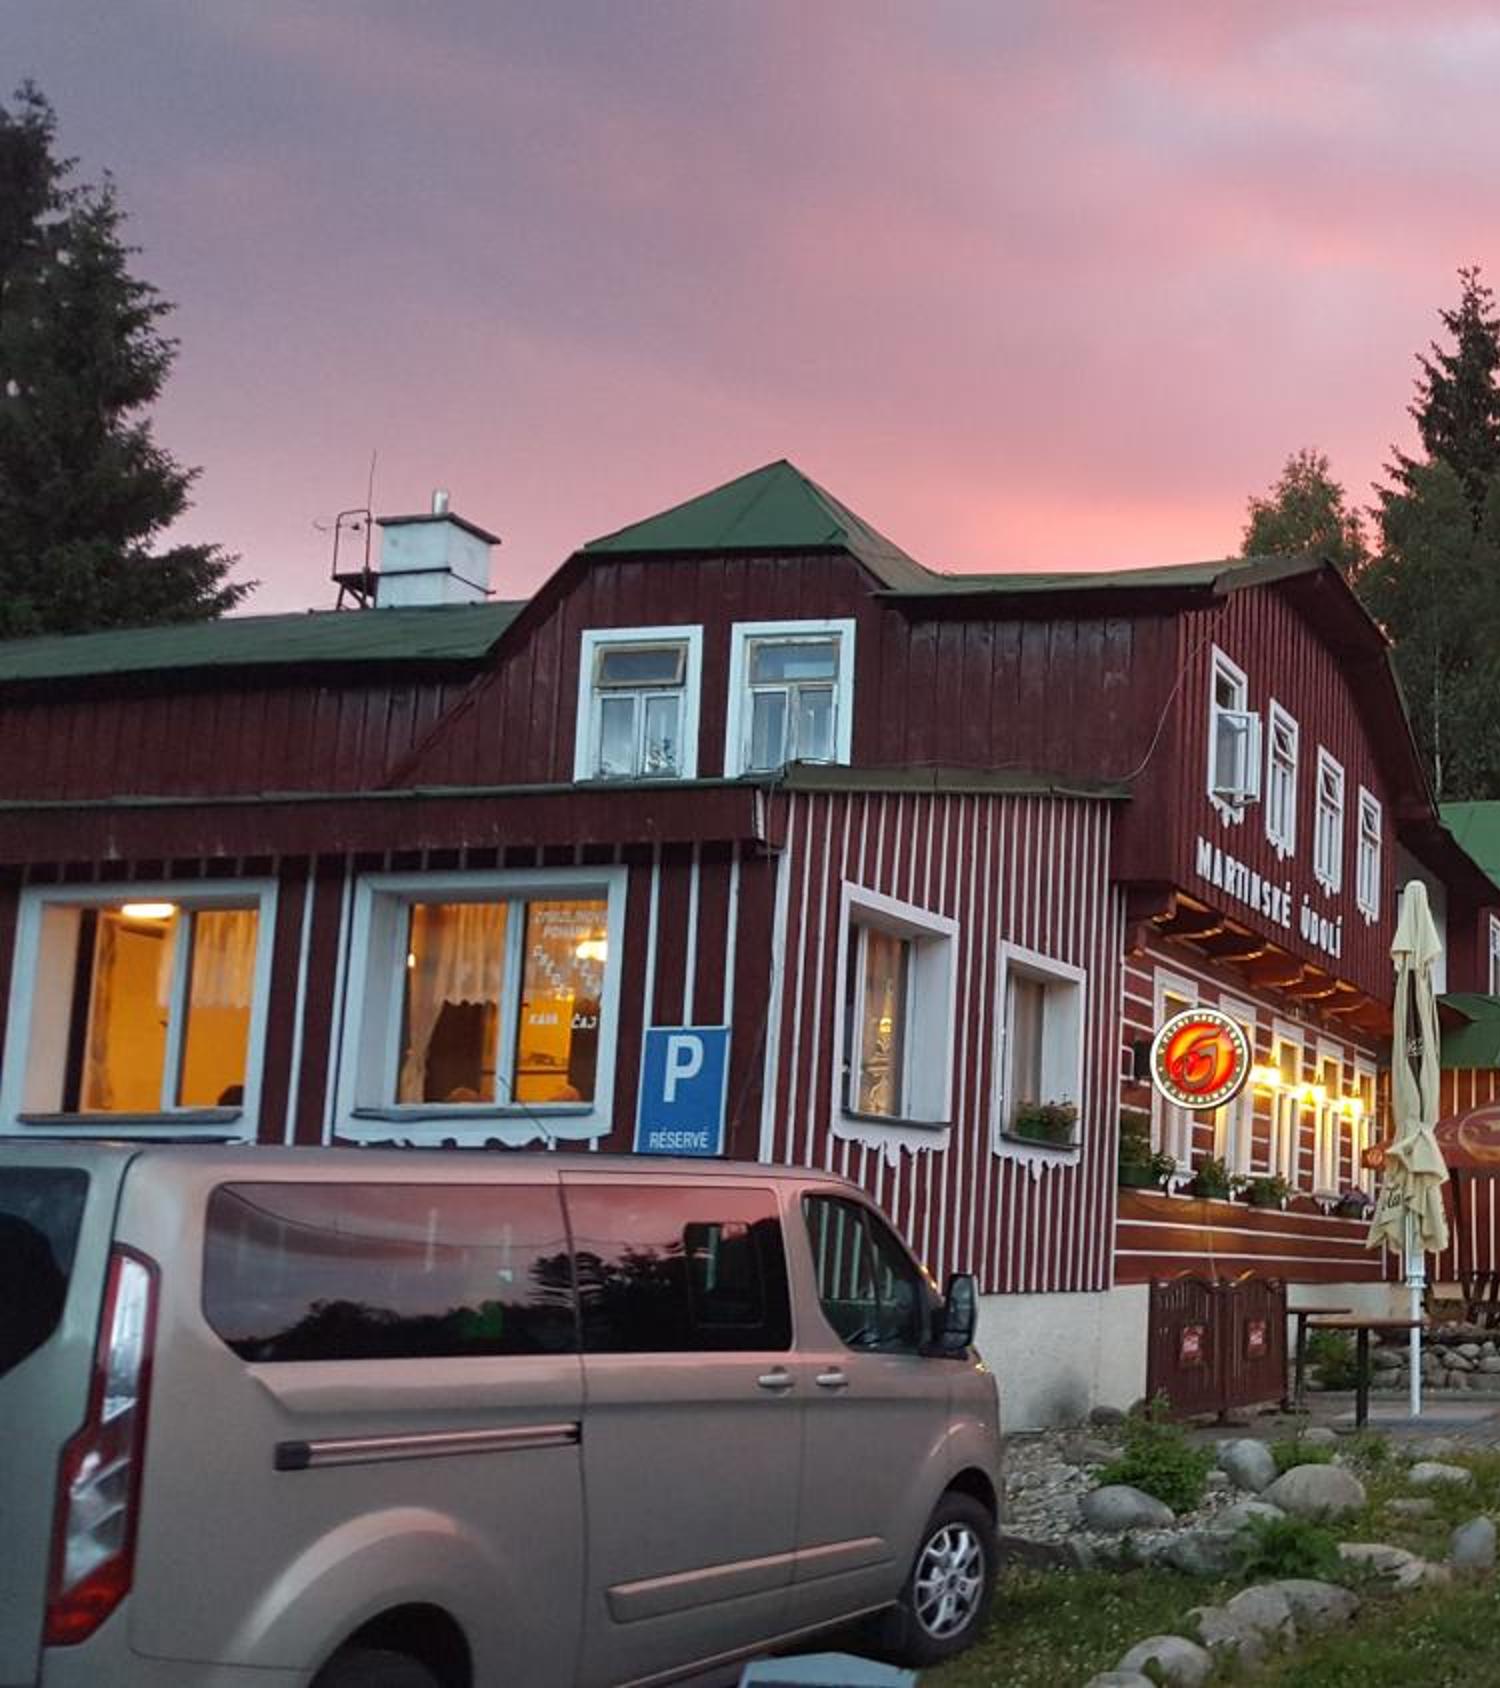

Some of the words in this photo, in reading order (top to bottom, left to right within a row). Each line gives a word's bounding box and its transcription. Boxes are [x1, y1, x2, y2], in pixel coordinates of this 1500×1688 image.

[1196, 836, 1291, 929] MARTINSKÉ
[1300, 894, 1342, 959] ÚDOLÍ
[663, 1035, 704, 1103] P
